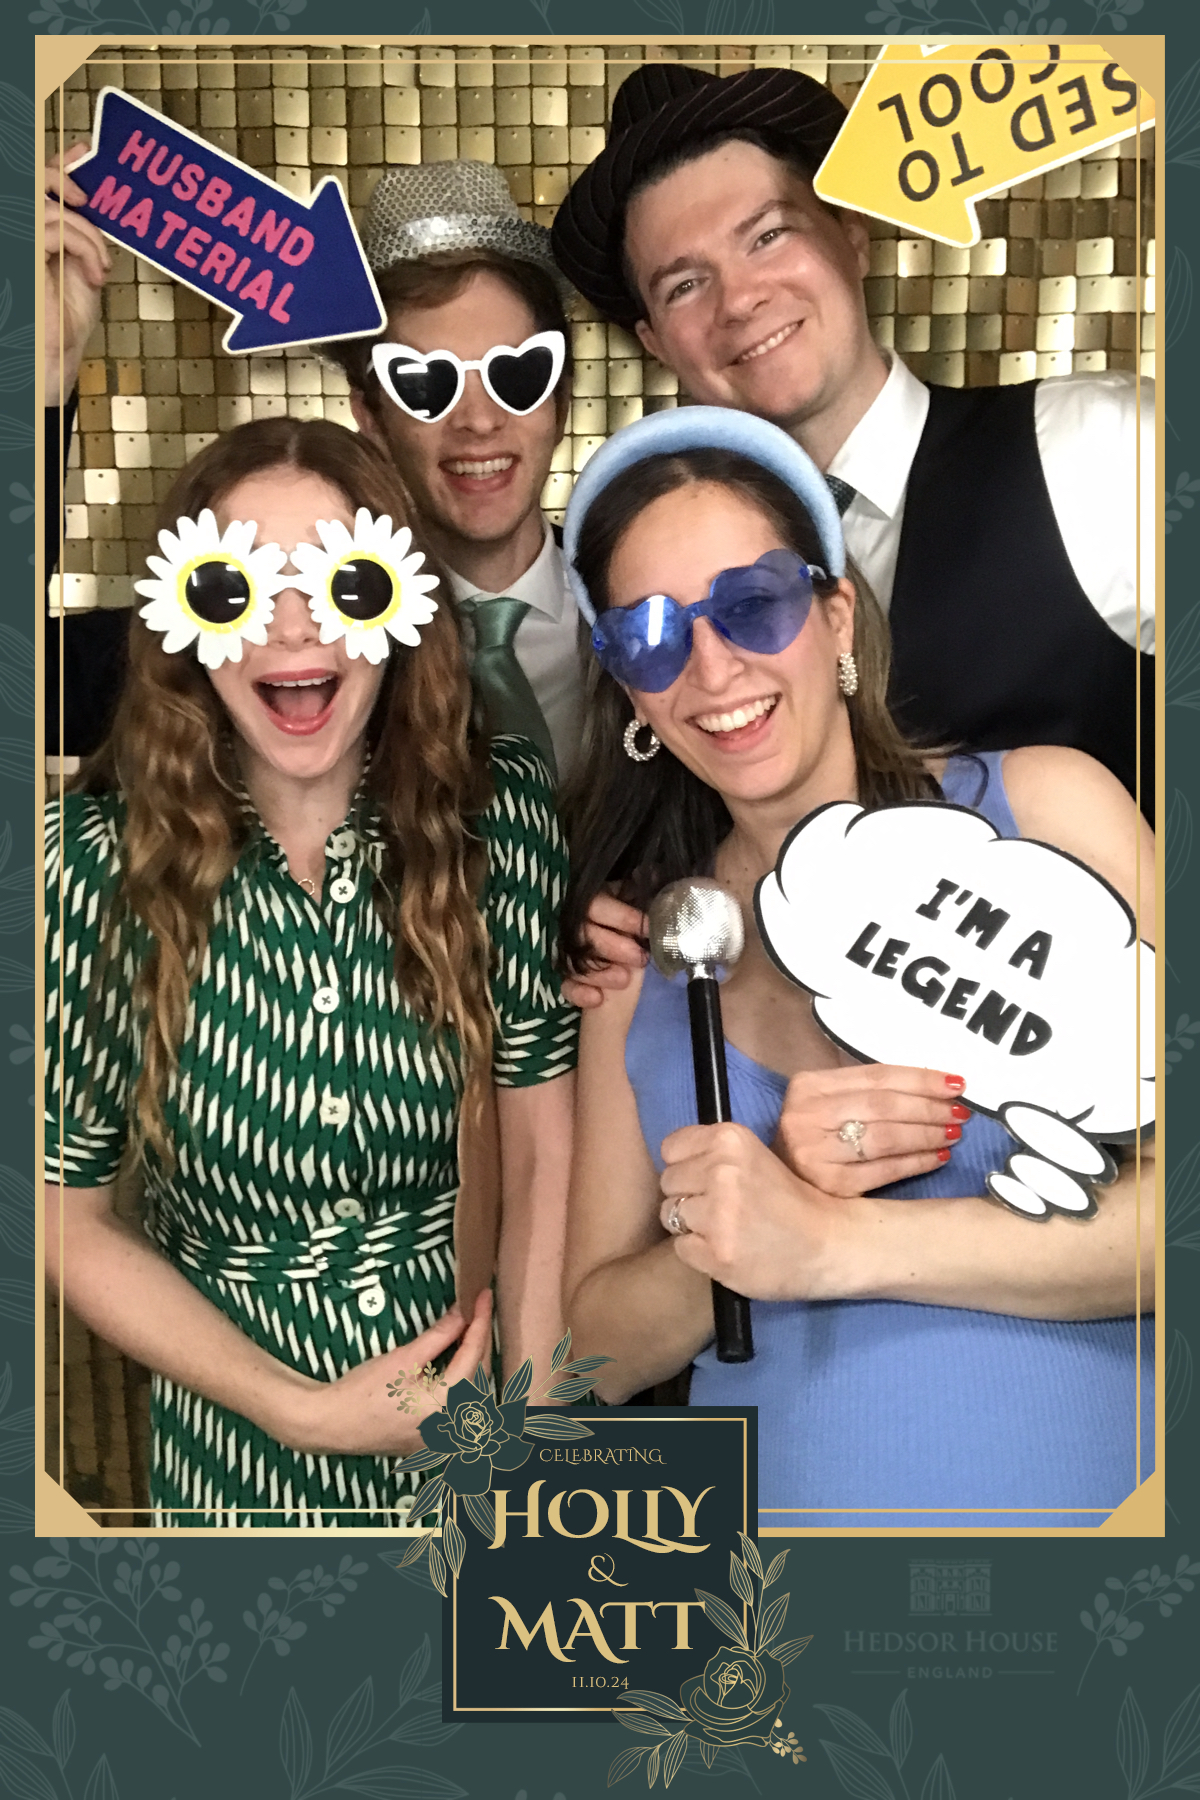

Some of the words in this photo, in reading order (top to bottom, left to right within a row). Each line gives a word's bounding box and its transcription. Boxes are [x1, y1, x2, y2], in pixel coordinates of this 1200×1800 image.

[118, 130, 315, 267] HUSBAND
[898, 132, 985, 202] TO
[89, 176, 295, 324] MATERIAL
[845, 921, 1053, 1056] LEGEND
[915, 878, 1011, 951] I'M
[1008, 930, 1053, 980] A
